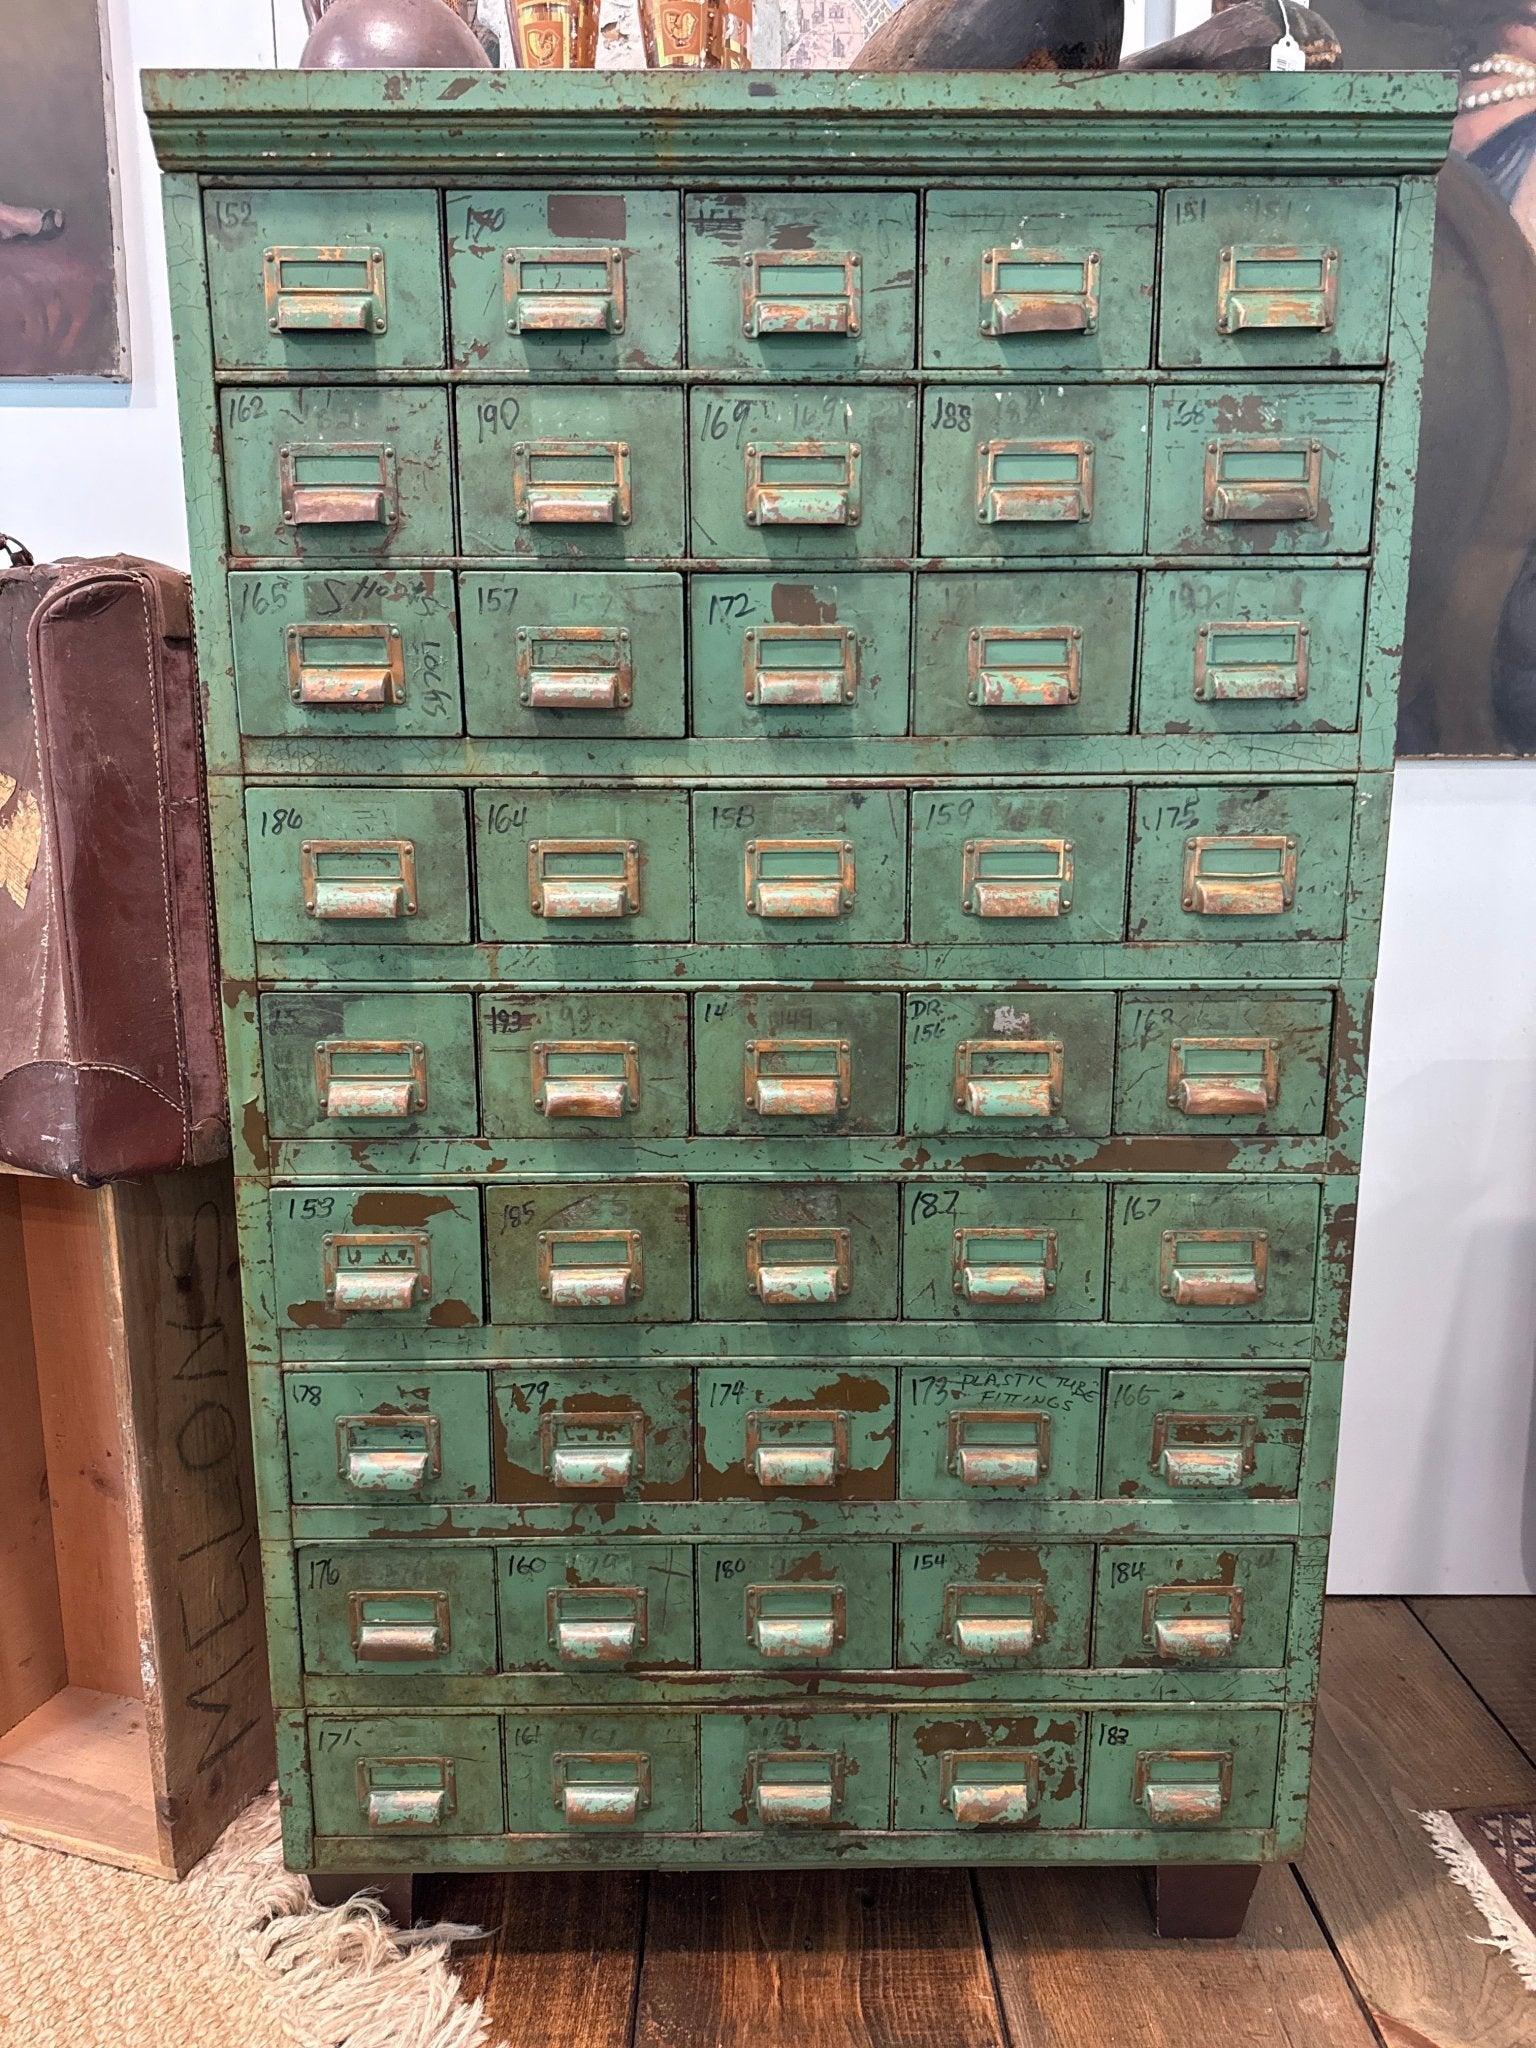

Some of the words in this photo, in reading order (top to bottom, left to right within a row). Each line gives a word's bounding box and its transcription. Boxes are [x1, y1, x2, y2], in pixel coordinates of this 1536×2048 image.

[214, 200, 253, 229] 152
[229, 394, 269, 429] 162
[477, 397, 520, 444] 190
[700, 399, 750, 450] 169
[931, 397, 972, 432] 188
[240, 576, 293, 623] 165
[477, 587, 519, 616] 157
[709, 592, 756, 625] 172
[261, 807, 303, 837] 186
[488, 803, 528, 836] 164
[712, 805, 755, 829] 158
[926, 798, 975, 830] 159
[289, 1197, 335, 1219] 153
[500, 1200, 535, 1236] 185
[1123, 1195, 1161, 1226] 167
[292, 1385, 322, 1407] 178
[511, 1381, 550, 1409] 179
[961, 1373, 1047, 1390] PLASTIC
[1056, 1376, 1100, 1403] TUBE
[981, 1390, 1073, 1412] FITTINGS
[1113, 1384, 1152, 1409] 166
[164, 1200, 259, 1774] MELONS
[308, 1558, 340, 1589] 176
[508, 1555, 546, 1577] 160
[715, 1558, 746, 1582] 180
[914, 1554, 946, 1571] 154
[1111, 1561, 1146, 1588] 184
